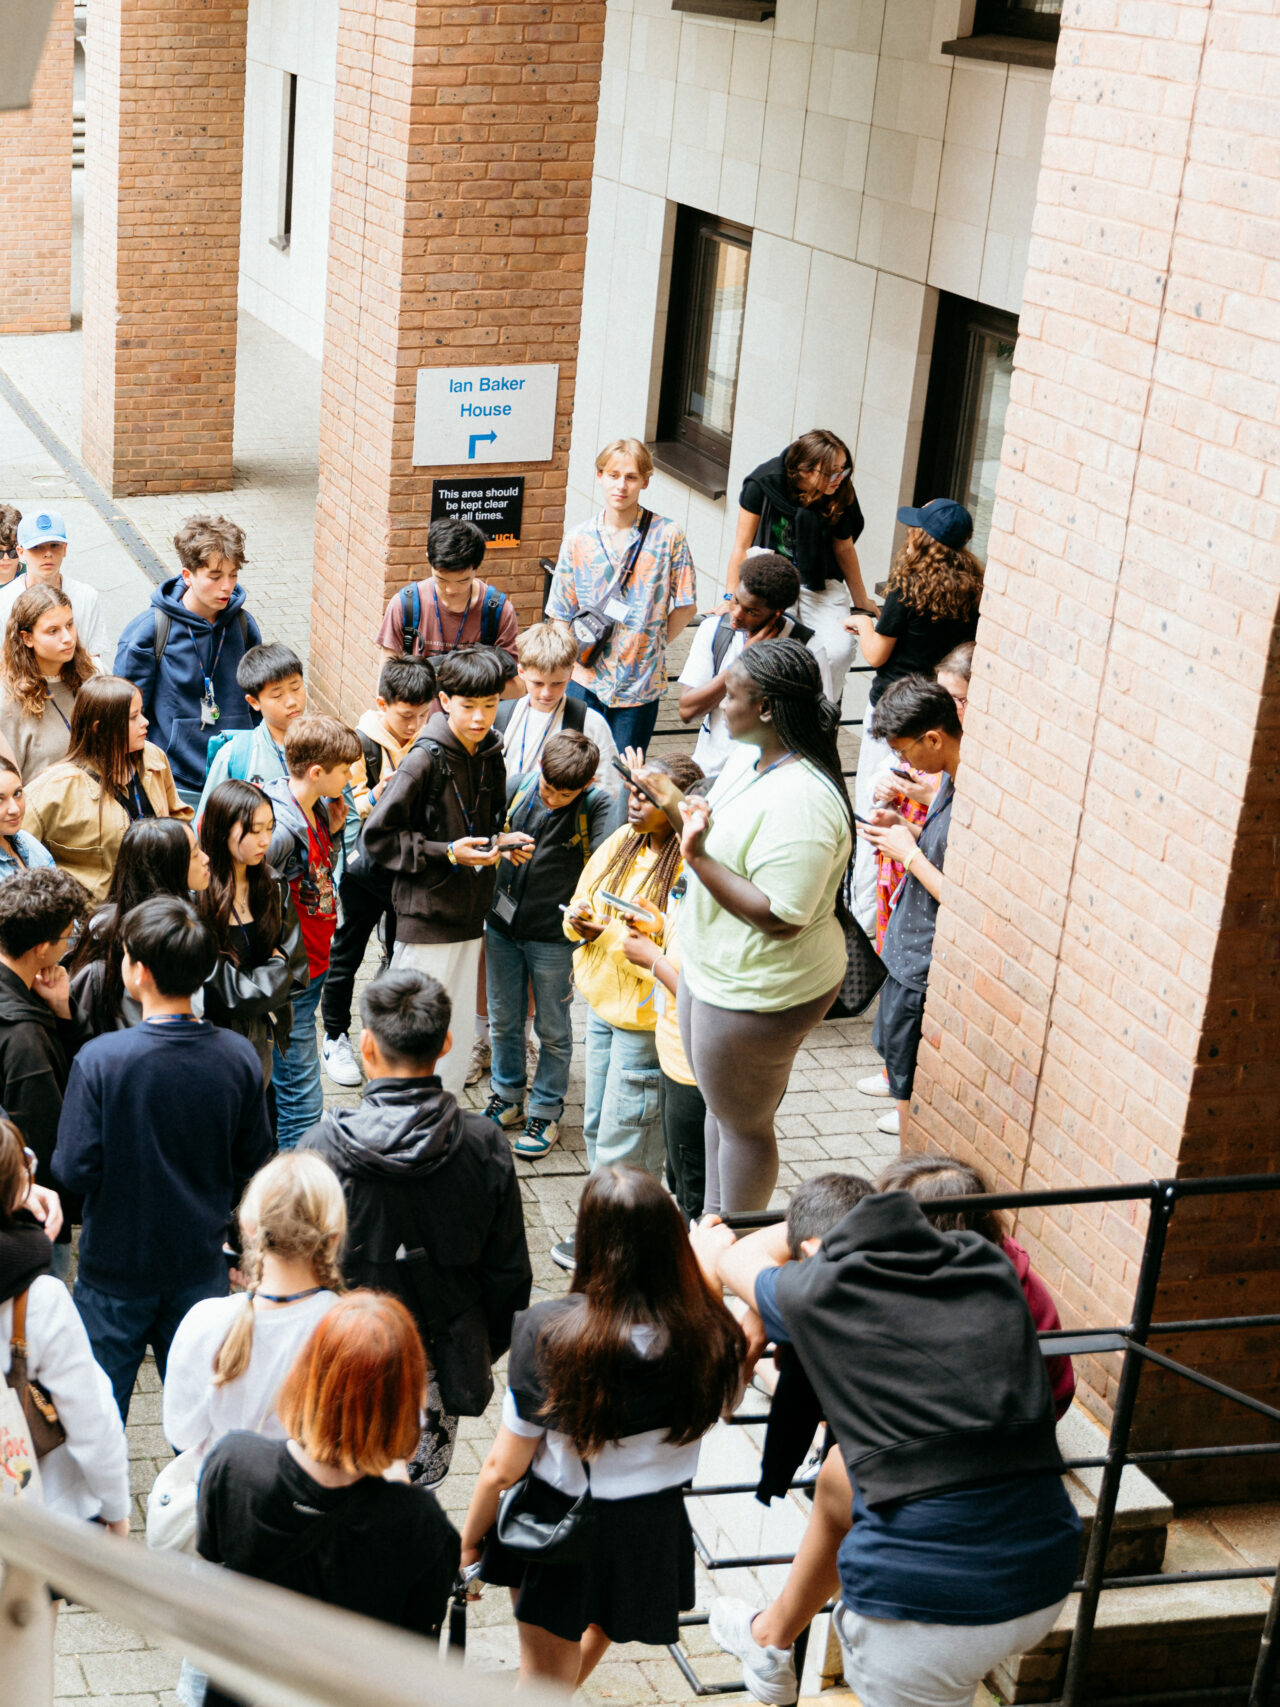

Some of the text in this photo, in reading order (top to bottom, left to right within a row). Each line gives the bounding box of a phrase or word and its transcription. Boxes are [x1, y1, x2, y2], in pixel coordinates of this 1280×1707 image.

[449, 376, 526, 393] Ian Baker
[460, 403, 512, 417] House
[438, 486, 519, 499] This area should
[445, 499, 509, 511] be kept clear
[449, 511, 504, 521] at all times.
